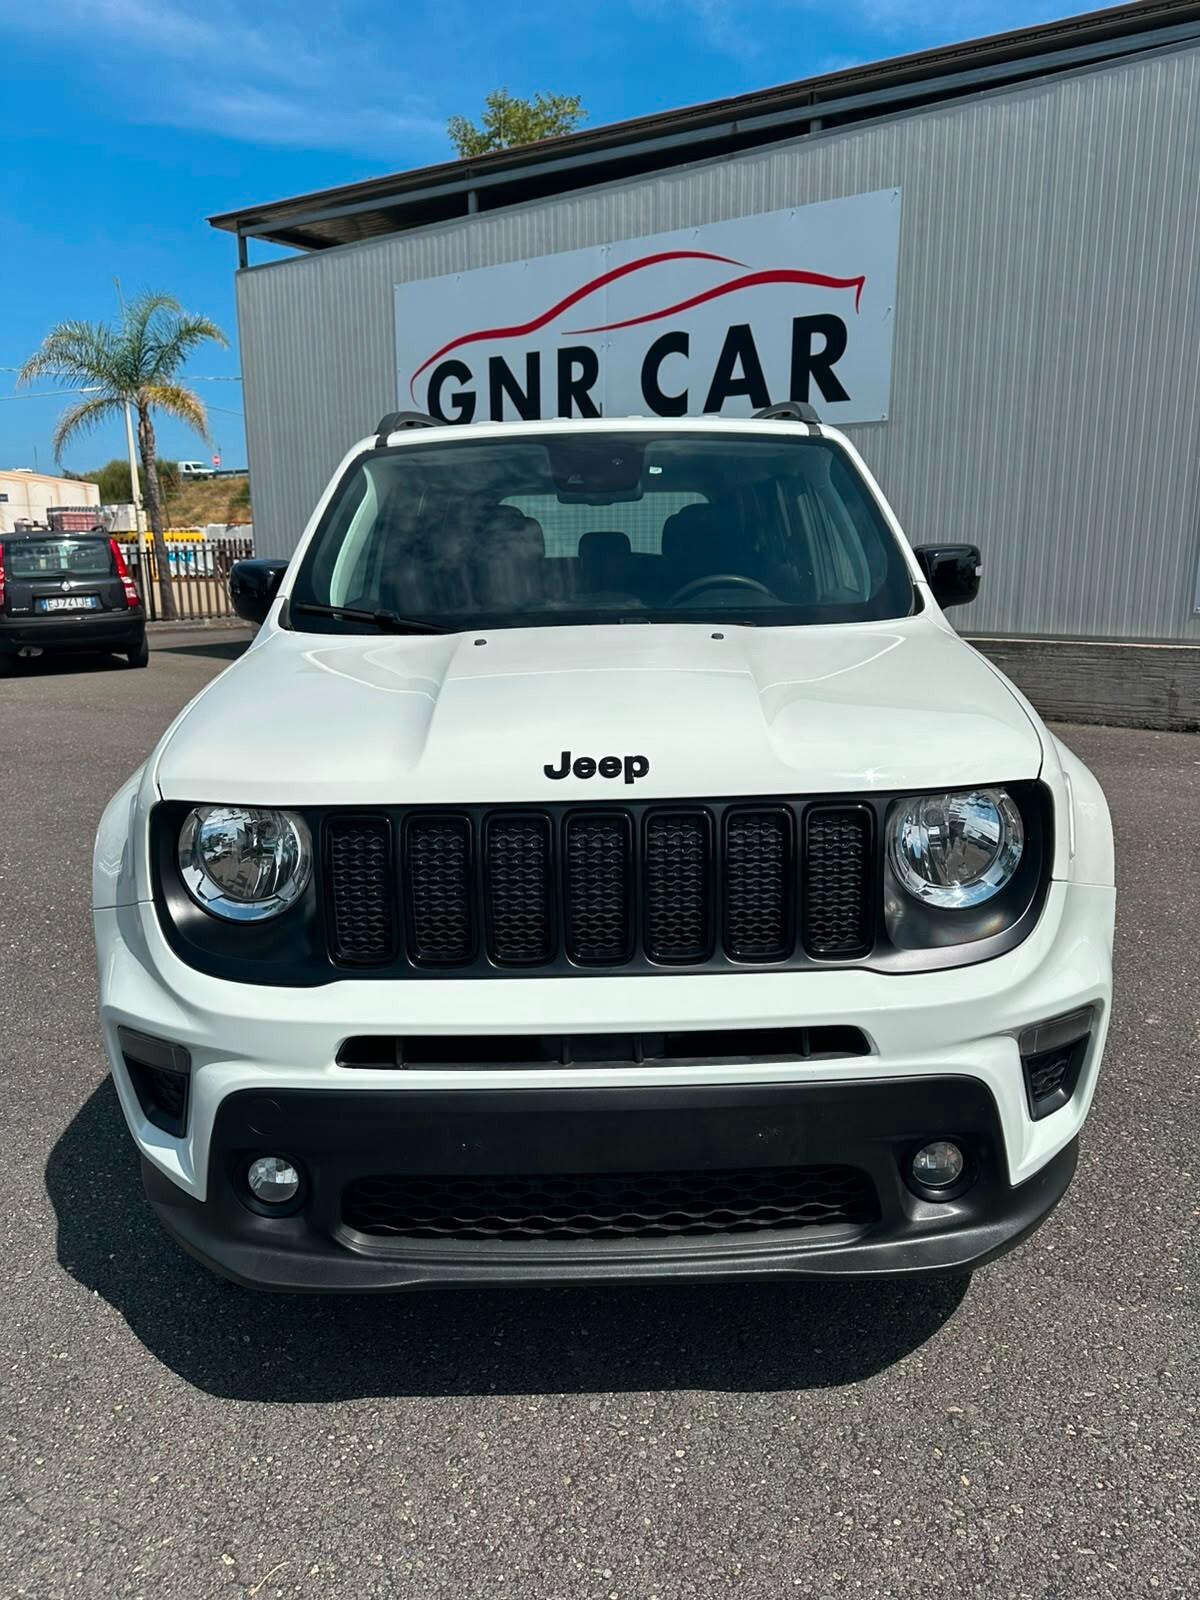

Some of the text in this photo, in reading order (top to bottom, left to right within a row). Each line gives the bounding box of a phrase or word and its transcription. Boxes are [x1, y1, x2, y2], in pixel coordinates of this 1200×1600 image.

[427, 313, 851, 424] GNR CAR
[543, 751, 650, 784] Jeep
